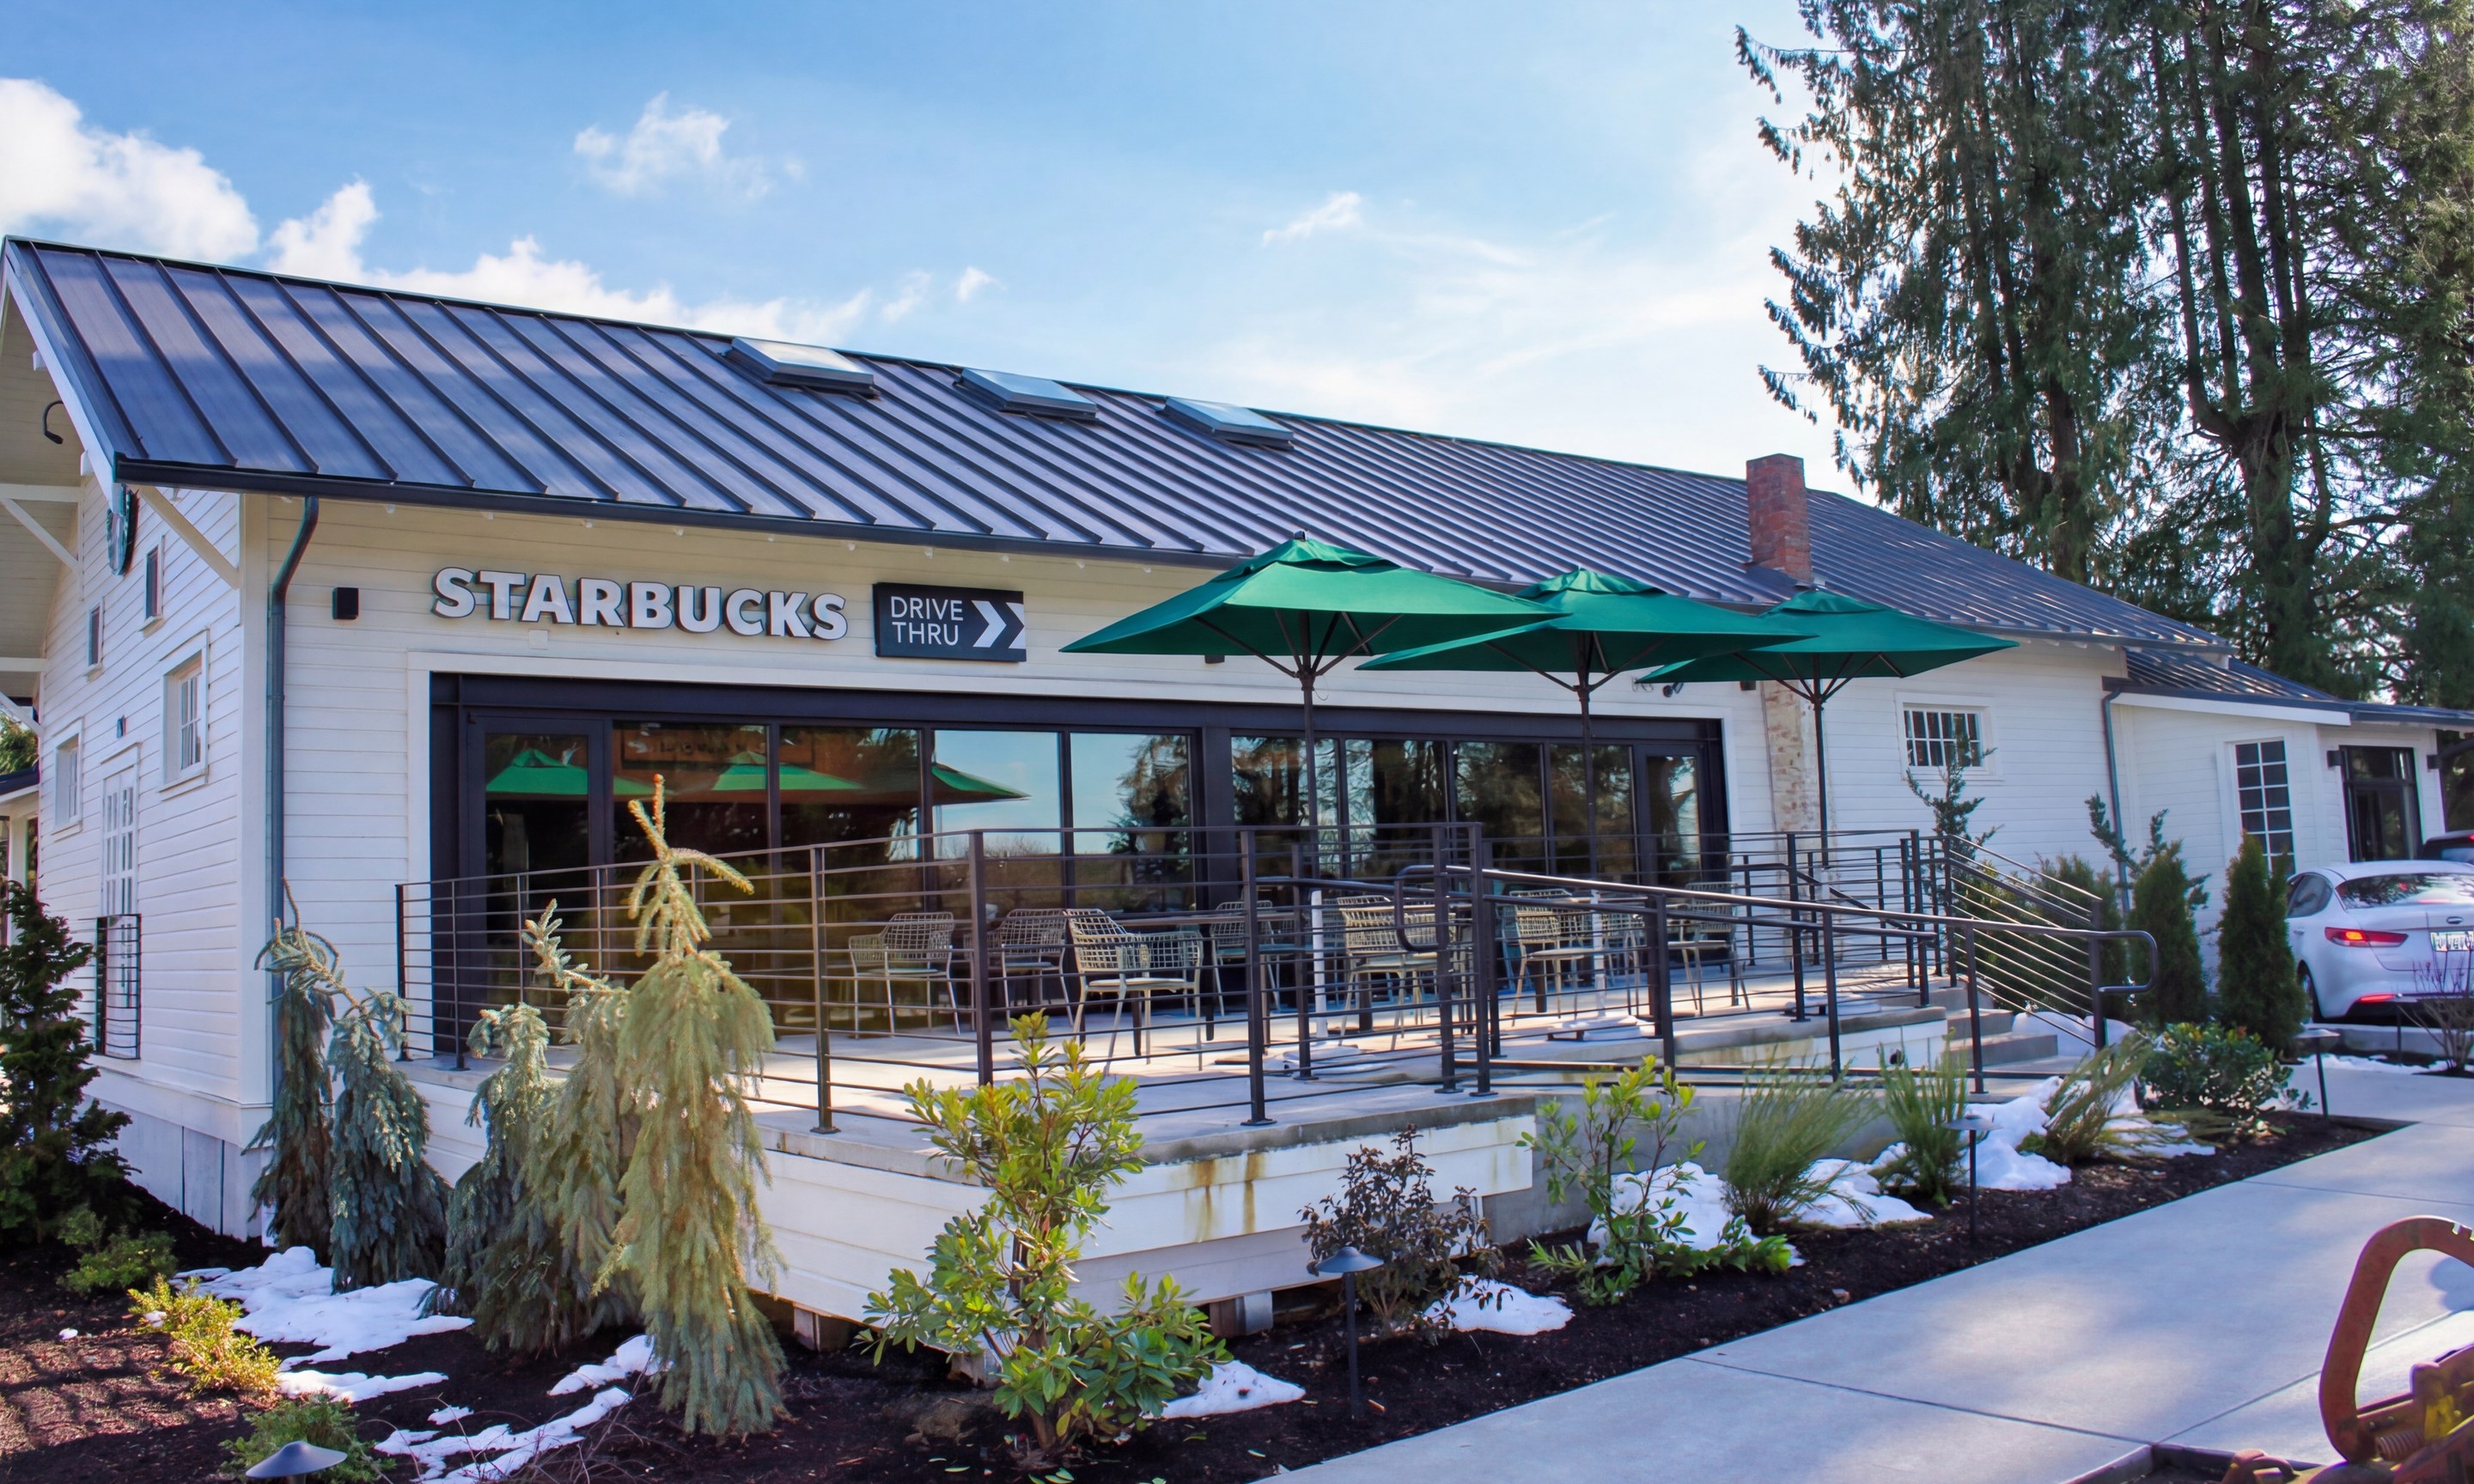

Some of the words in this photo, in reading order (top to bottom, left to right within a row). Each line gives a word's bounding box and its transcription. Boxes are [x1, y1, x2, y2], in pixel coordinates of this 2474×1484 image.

[432, 567, 849, 641] STARBUCKS
[891, 596, 964, 621] DRIVE
[892, 622, 959, 646] THRU
